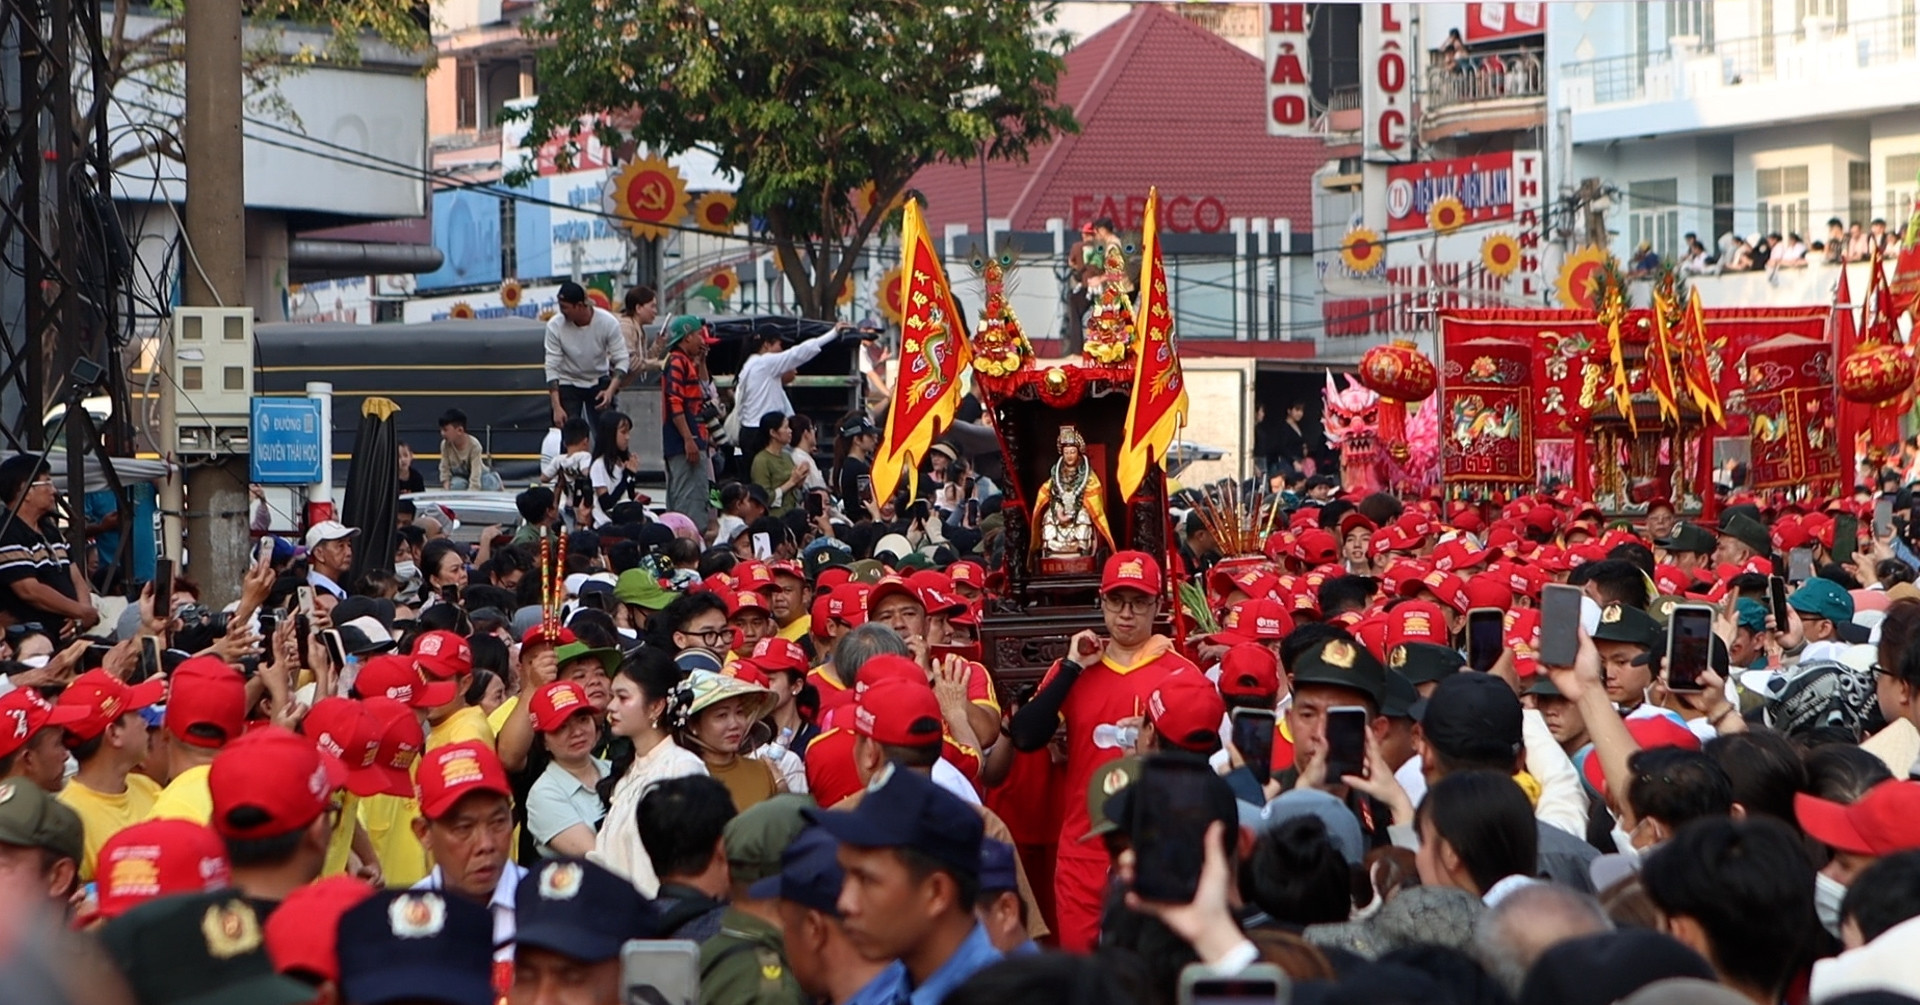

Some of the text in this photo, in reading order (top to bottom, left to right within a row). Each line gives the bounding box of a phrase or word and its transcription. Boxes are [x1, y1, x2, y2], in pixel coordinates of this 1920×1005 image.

[1378, 3, 1405, 150] LỘC
[273, 416, 301, 431] ĐƯỜNG
[258, 440, 317, 466] NGUYỄN THÁI HỌC
